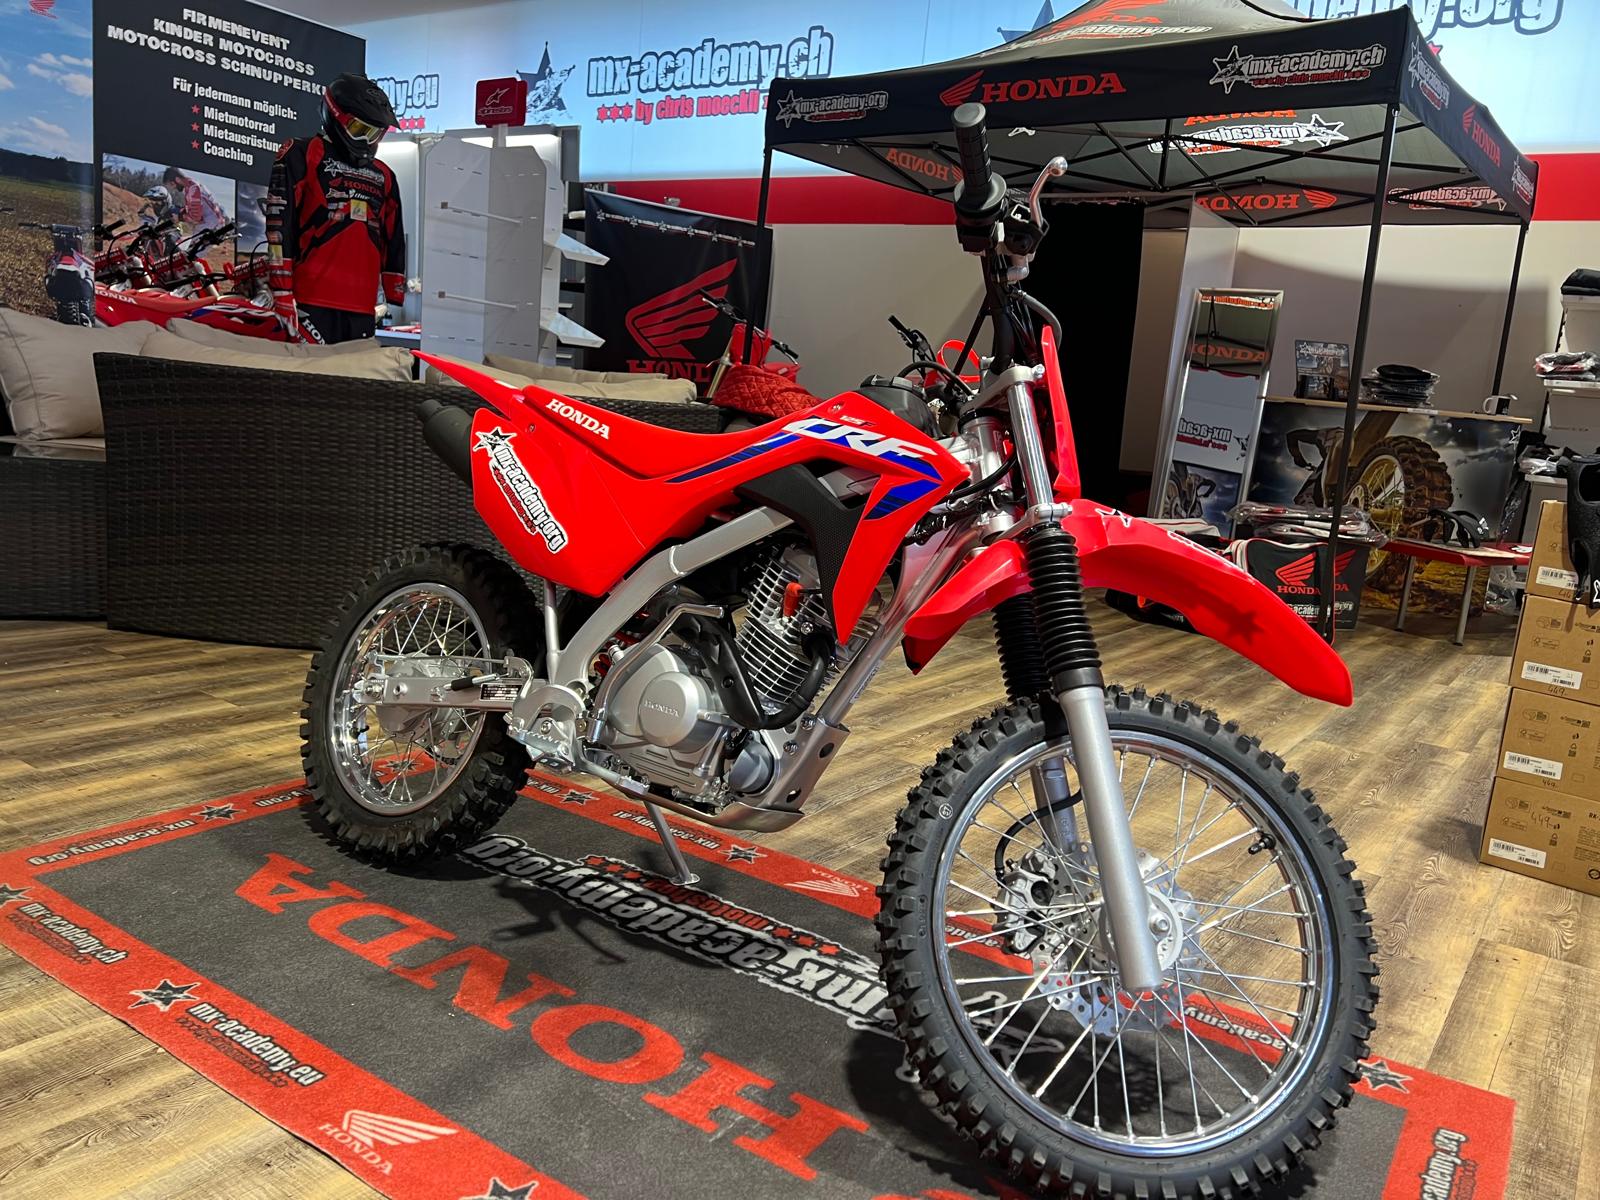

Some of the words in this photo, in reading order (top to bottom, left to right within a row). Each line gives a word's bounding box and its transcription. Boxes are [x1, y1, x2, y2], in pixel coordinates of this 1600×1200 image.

[107, 24, 216, 66] MOTOCROSS
[153, 18, 214, 47] KINDER
[218, 37, 315, 76] MOTOCROSS
[183, 8, 291, 51] FIRMENEVENT
[587, 25, 834, 97] mx-academy.ch
[1249, 45, 1385, 75] mx-academy.ch
[172, 77, 193, 93] Für
[194, 82, 251, 109] jedermann
[253, 99, 298, 121] möglich:
[635, 98, 654, 125] by
[655, 94, 694, 120] chris
[800, 92, 888, 113] mx-academy.org
[981, 73, 1127, 103] HONDA
[204, 106, 276, 134] Mietmotorrad
[203, 141, 254, 166] Coaching
[1472, 119, 1502, 167] HONDA
[545, 398, 610, 440] HONDA
[782, 418, 938, 459] CRF
[494, 447, 566, 551] mx-academy.org
[644, 698, 680, 718] HONDA
[28, 819, 198, 867] mx-academy.org
[811, 868, 869, 892] HONDA
[466, 836, 889, 1016] mx-academy.org
[643, 878, 770, 931] motoshop
[17, 901, 129, 965] mx-academy.ch
[233, 852, 869, 1181] HONDA
[186, 1002, 327, 1087] mx-academy.eu
[319, 1122, 395, 1176] HONDA
